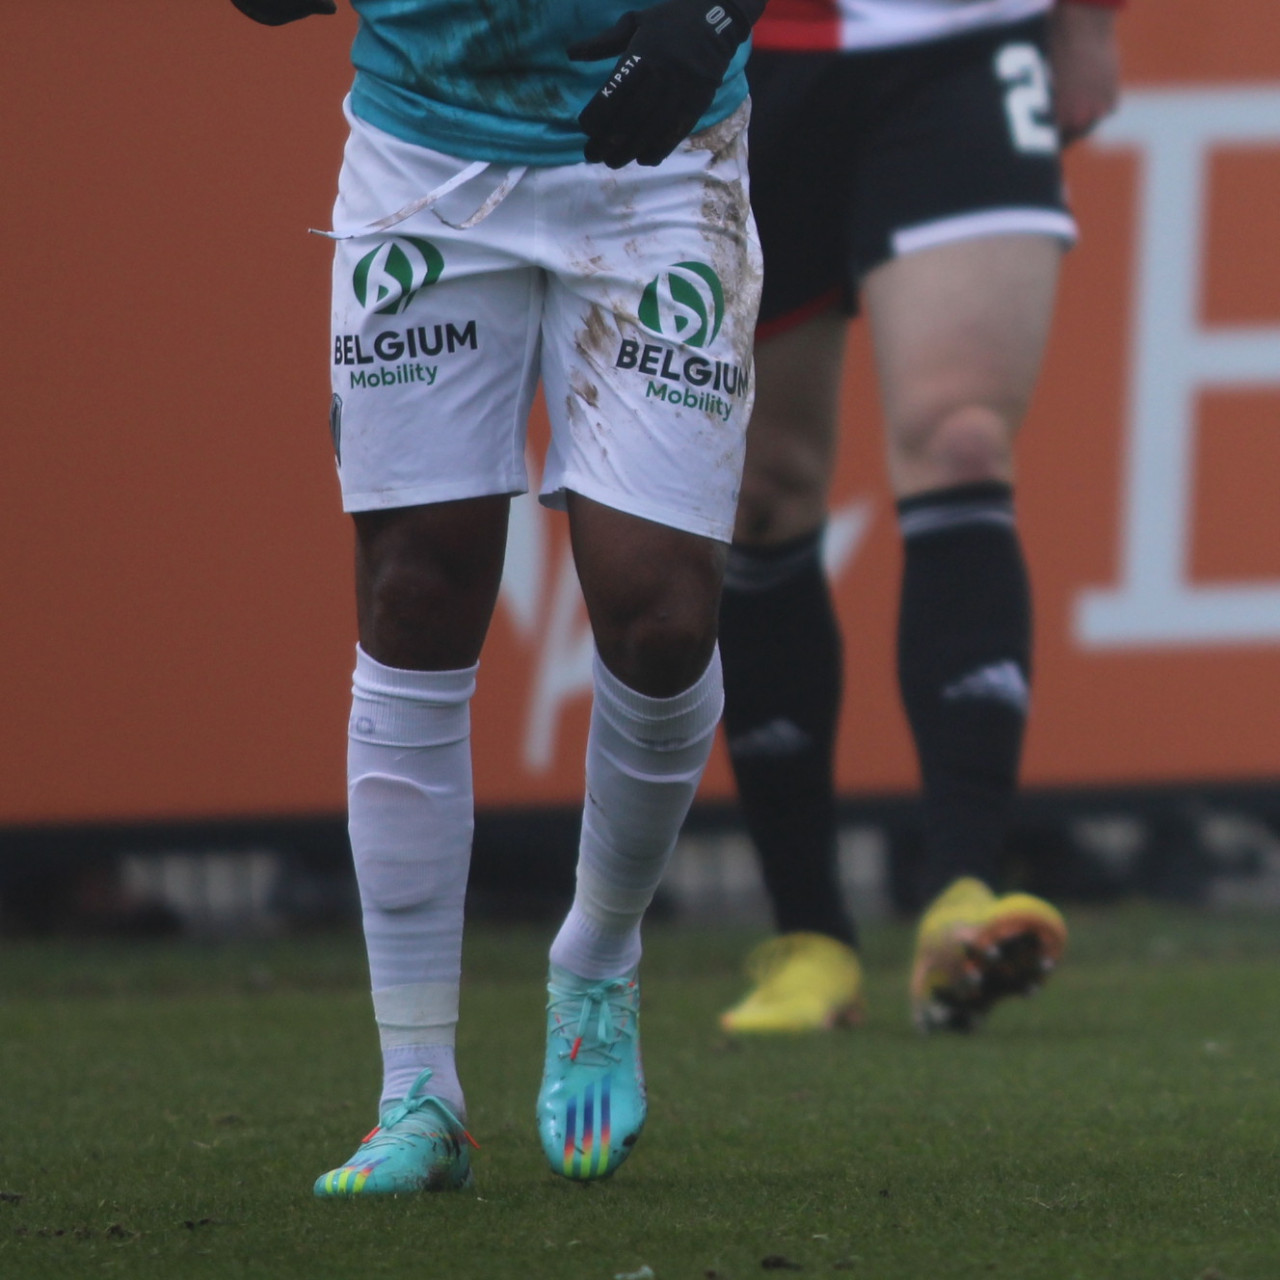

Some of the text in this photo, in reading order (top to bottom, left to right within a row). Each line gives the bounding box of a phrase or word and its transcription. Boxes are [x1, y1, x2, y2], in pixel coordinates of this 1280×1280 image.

[601, 55, 642, 98] KIPSTA
[993, 42, 1058, 154] 2
[334, 320, 478, 366] BELGIUM
[350, 363, 438, 390] Mobility
[615, 338, 750, 398] BELGIUM
[645, 380, 733, 422] Mobility
